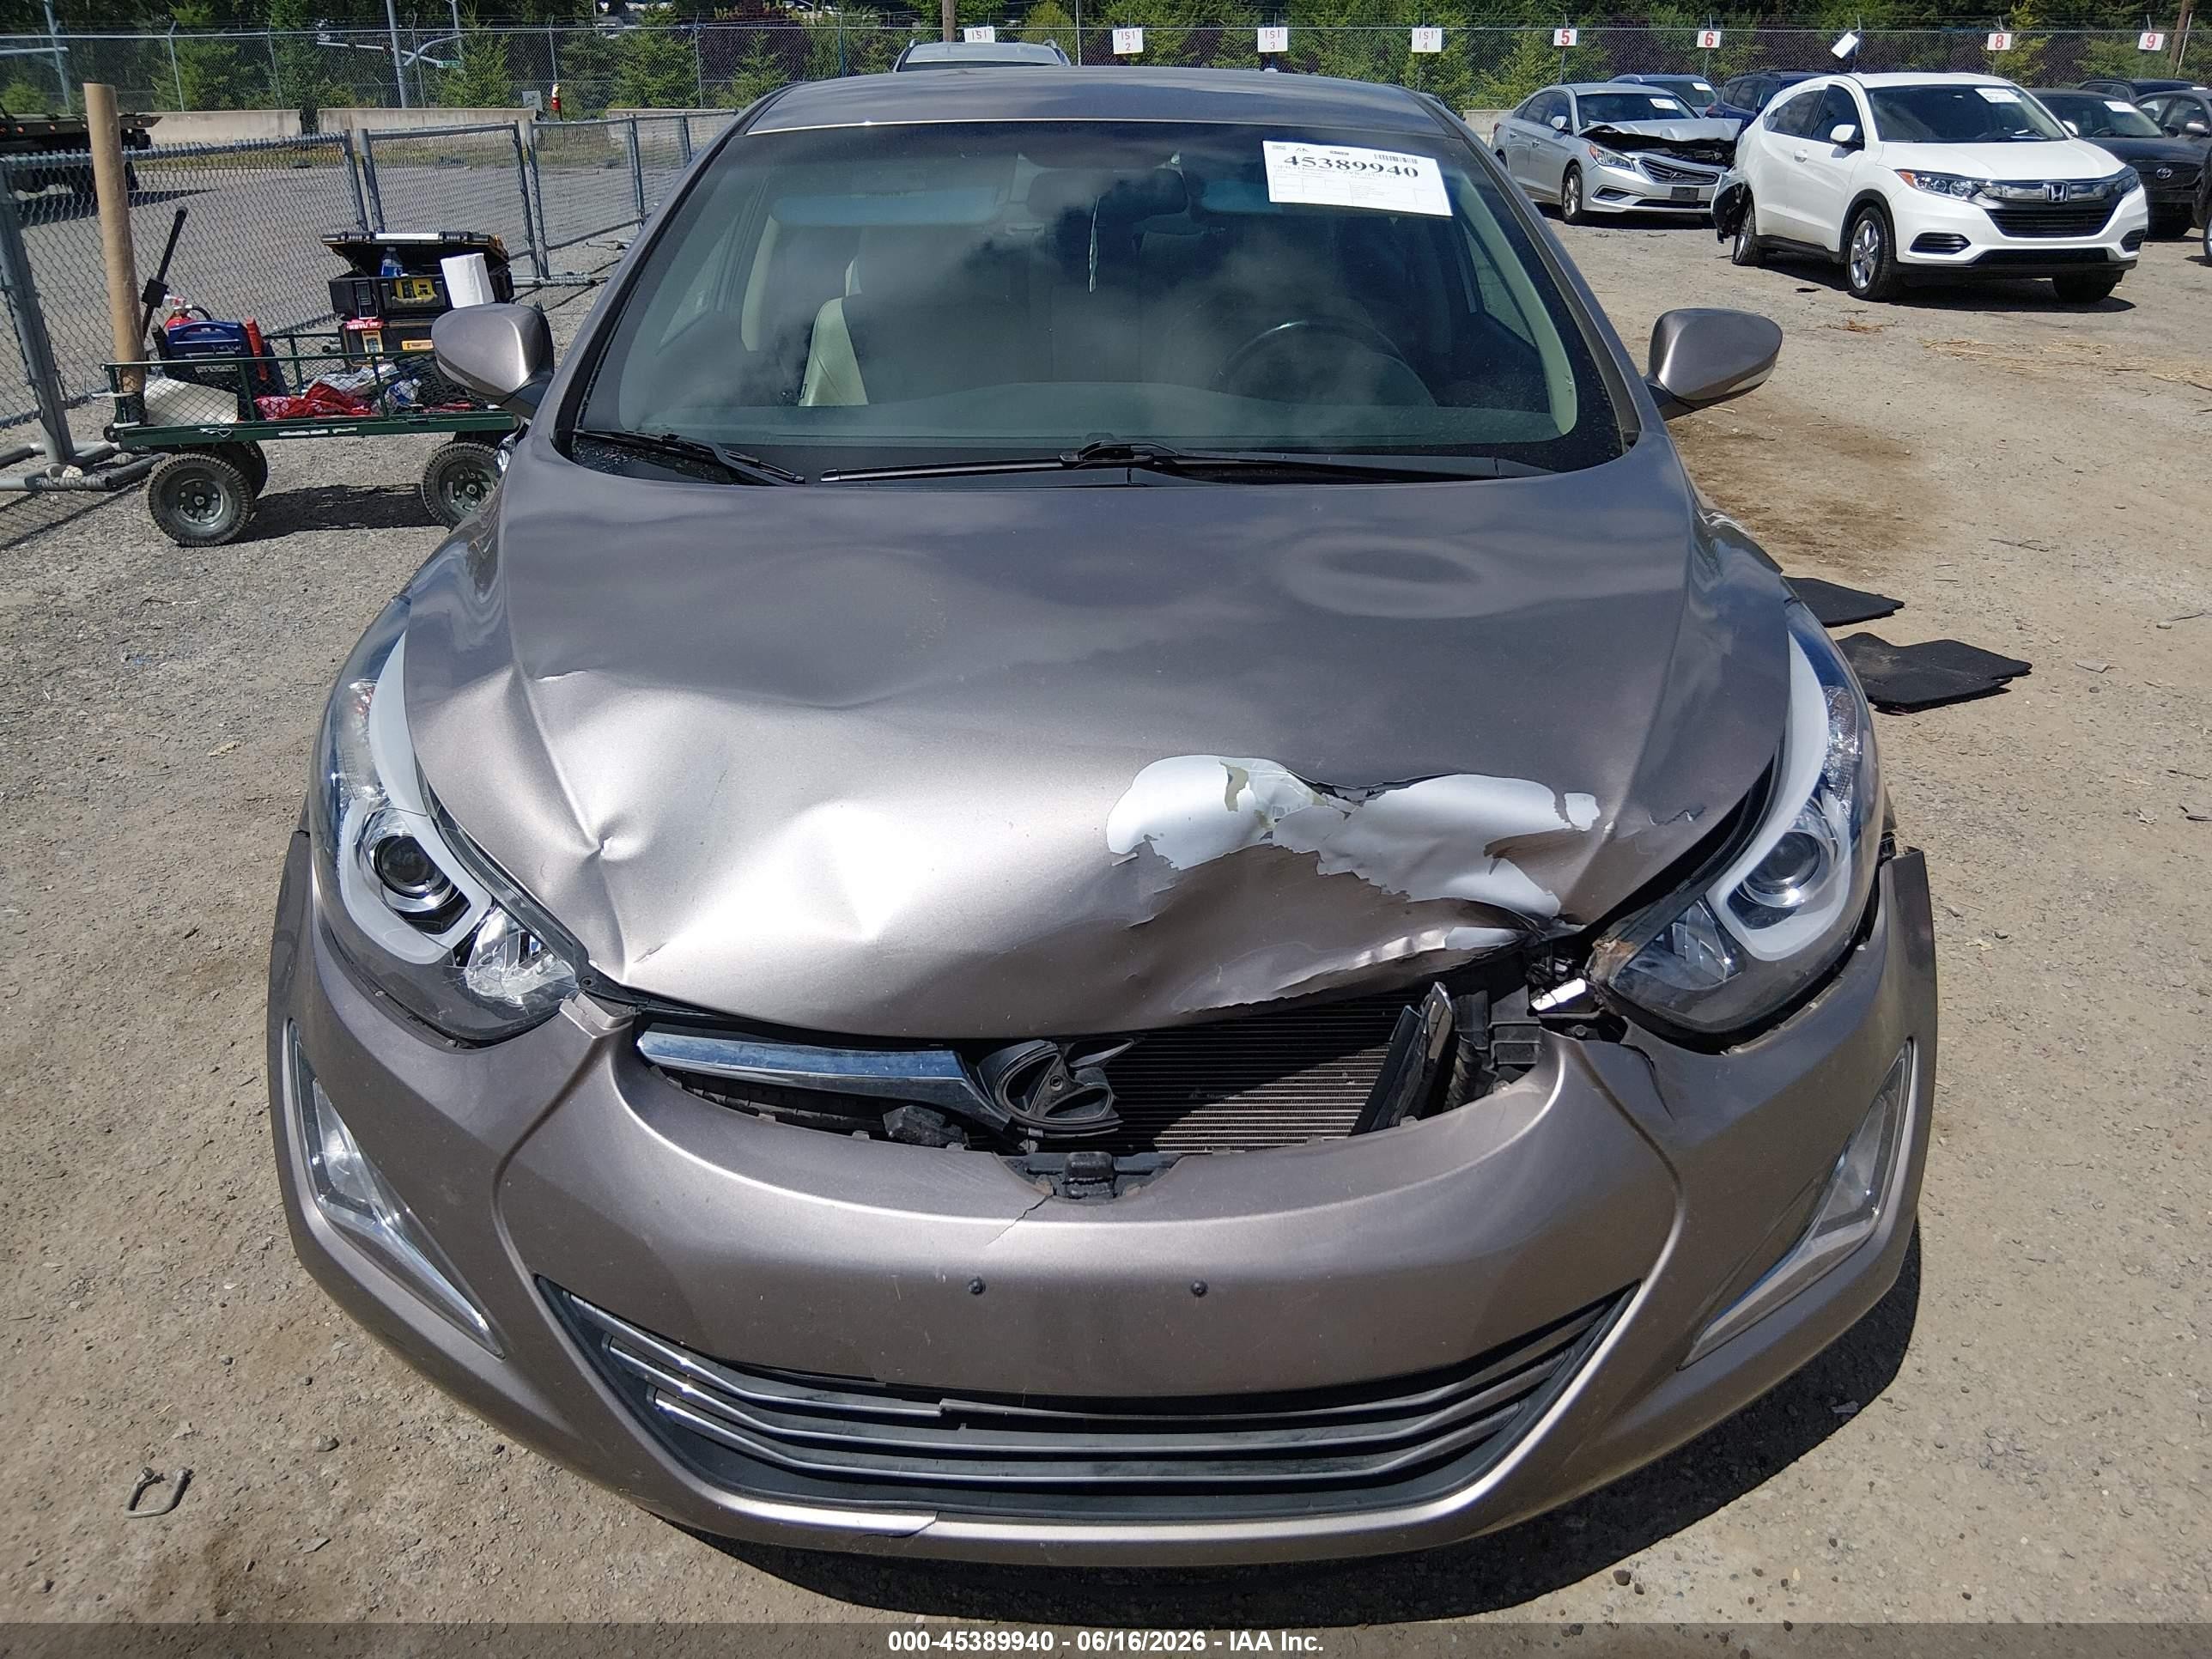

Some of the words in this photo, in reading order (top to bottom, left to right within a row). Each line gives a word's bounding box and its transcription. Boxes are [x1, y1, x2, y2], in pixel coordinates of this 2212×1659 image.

[1561, 29, 1571, 46] 5
[1705, 31, 1714, 46] 6
[1996, 33, 2004, 49] 8
[2146, 33, 2156, 49] 9
[1125, 42, 1131, 52] 2
[1270, 41, 1276, 50] 3
[1422, 41, 1428, 51] 4
[1284, 155, 1419, 179] 45389940
